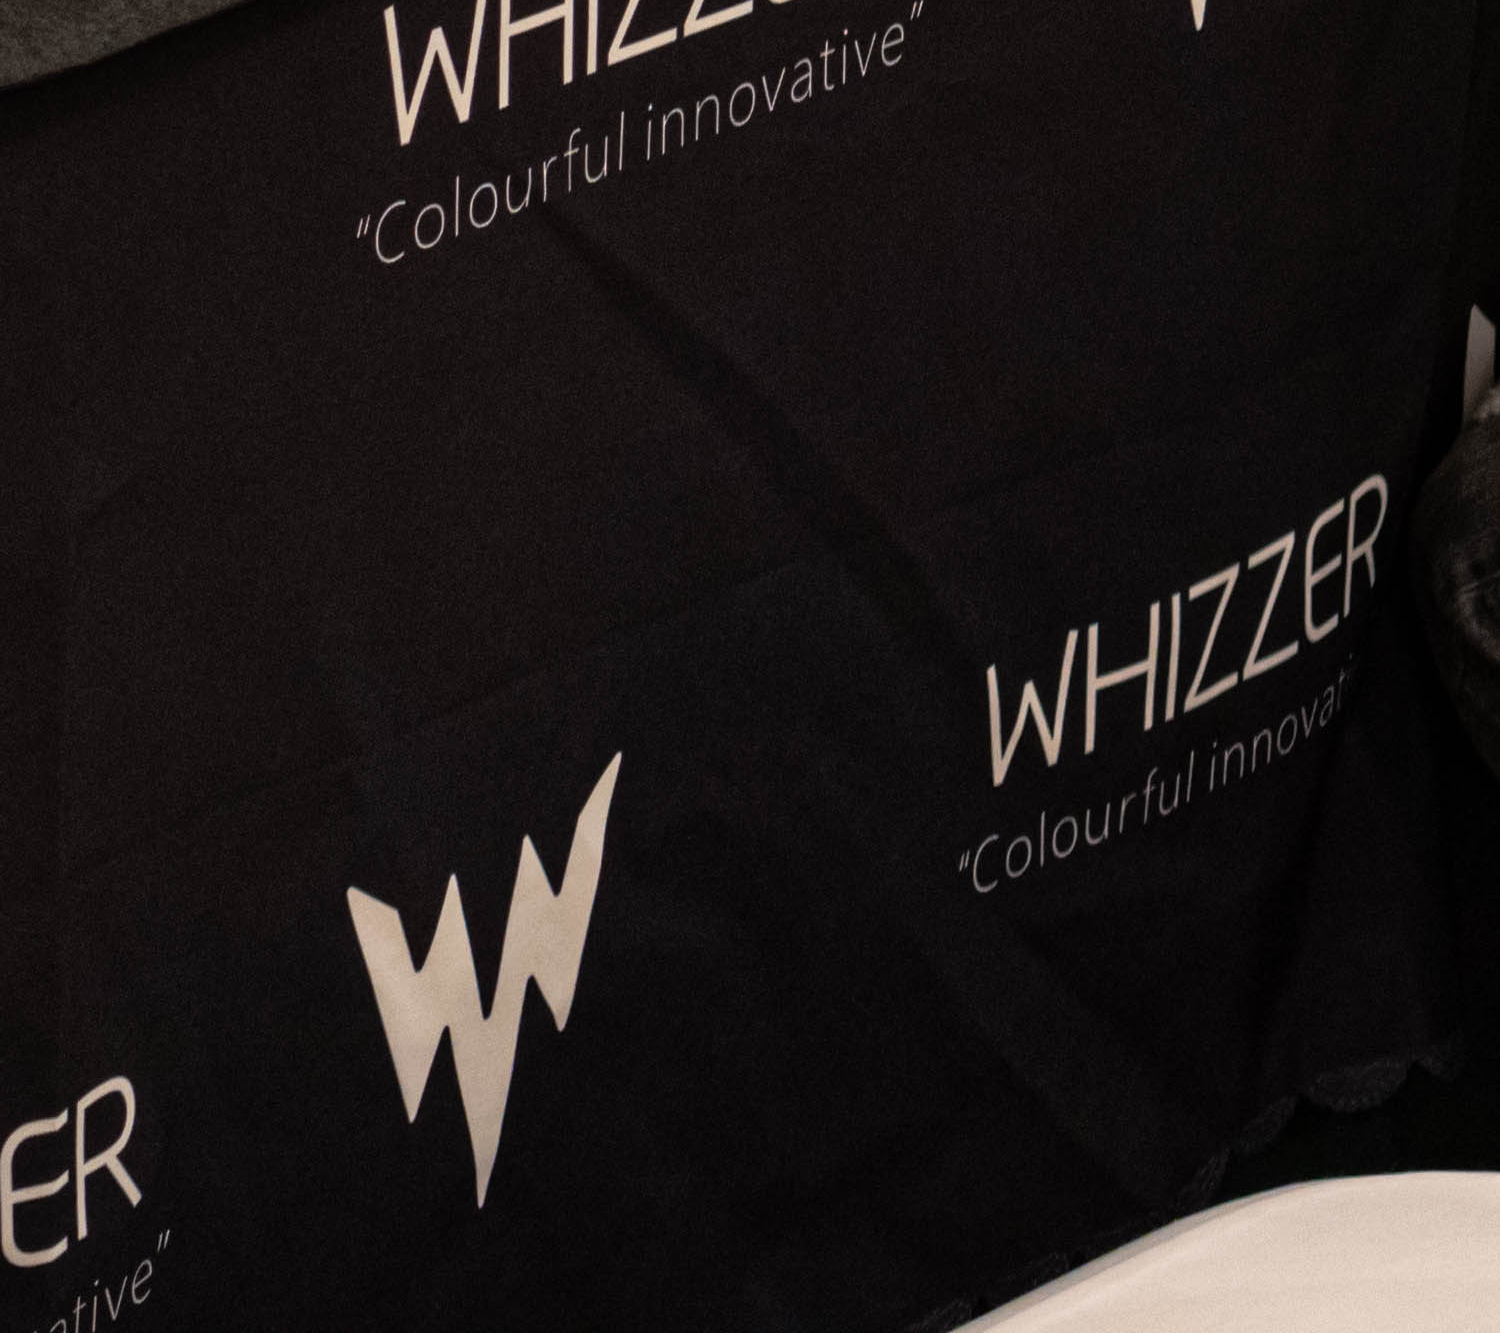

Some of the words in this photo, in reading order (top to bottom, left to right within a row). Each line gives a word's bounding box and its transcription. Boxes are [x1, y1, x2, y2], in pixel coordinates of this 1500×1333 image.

[356, 110, 627, 264] "Colourful
[646, 0, 924, 161] innovative"
[987, 474, 1389, 787] WHIZZER
[958, 750, 1196, 894] "Colourful
